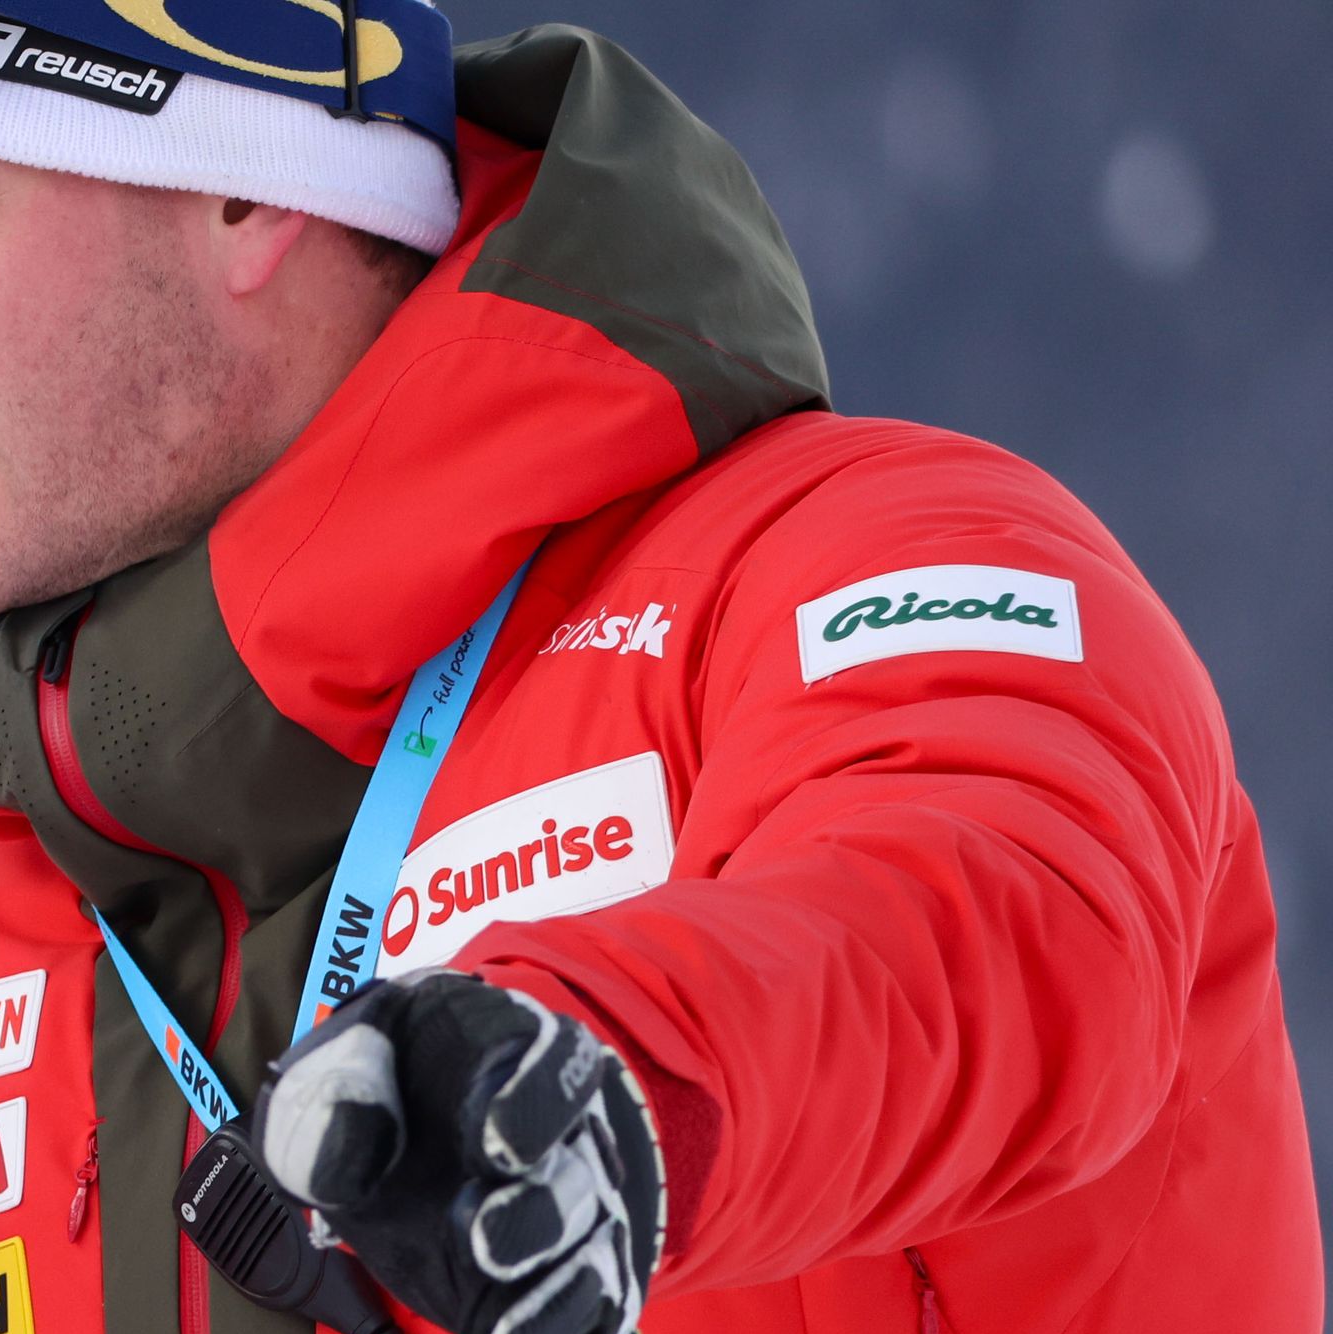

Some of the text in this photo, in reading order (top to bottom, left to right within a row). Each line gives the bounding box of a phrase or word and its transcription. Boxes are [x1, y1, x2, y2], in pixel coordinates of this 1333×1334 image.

[15, 47, 167, 102] reusch
[822, 591, 1058, 643] Ricola
[426, 818, 634, 926] Sunrise
[320, 893, 374, 1001] BKW
[180, 1047, 228, 1125] BKW
[192, 1154, 229, 1206] MOTOROLA
